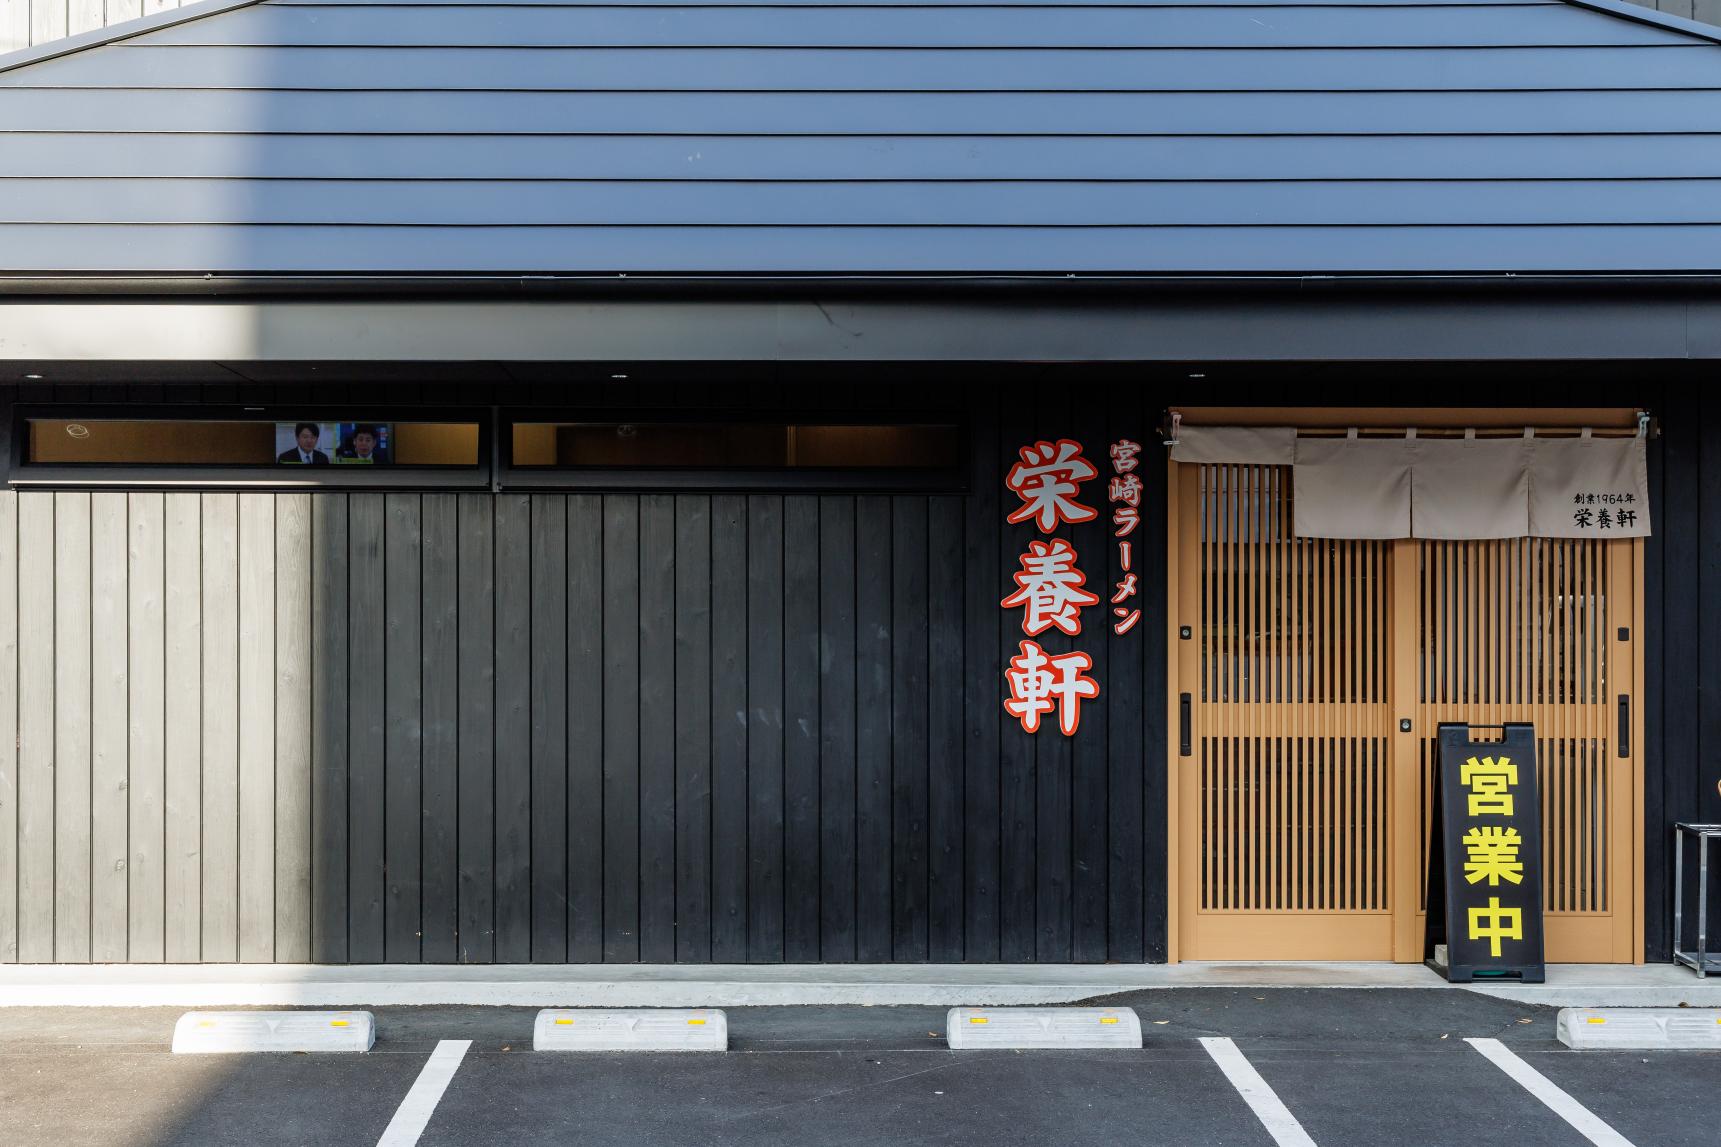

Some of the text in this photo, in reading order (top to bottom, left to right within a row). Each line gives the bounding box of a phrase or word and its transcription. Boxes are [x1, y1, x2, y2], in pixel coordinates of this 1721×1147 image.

[1001, 439, 1099, 736] 栄養軒
[1109, 439, 1143, 635] 宮崎ラーメン
[1573, 507, 1637, 529] 栄養軒
[1574, 493, 1636, 505] 創業1964年
[1460, 756, 1524, 957] 営業中
